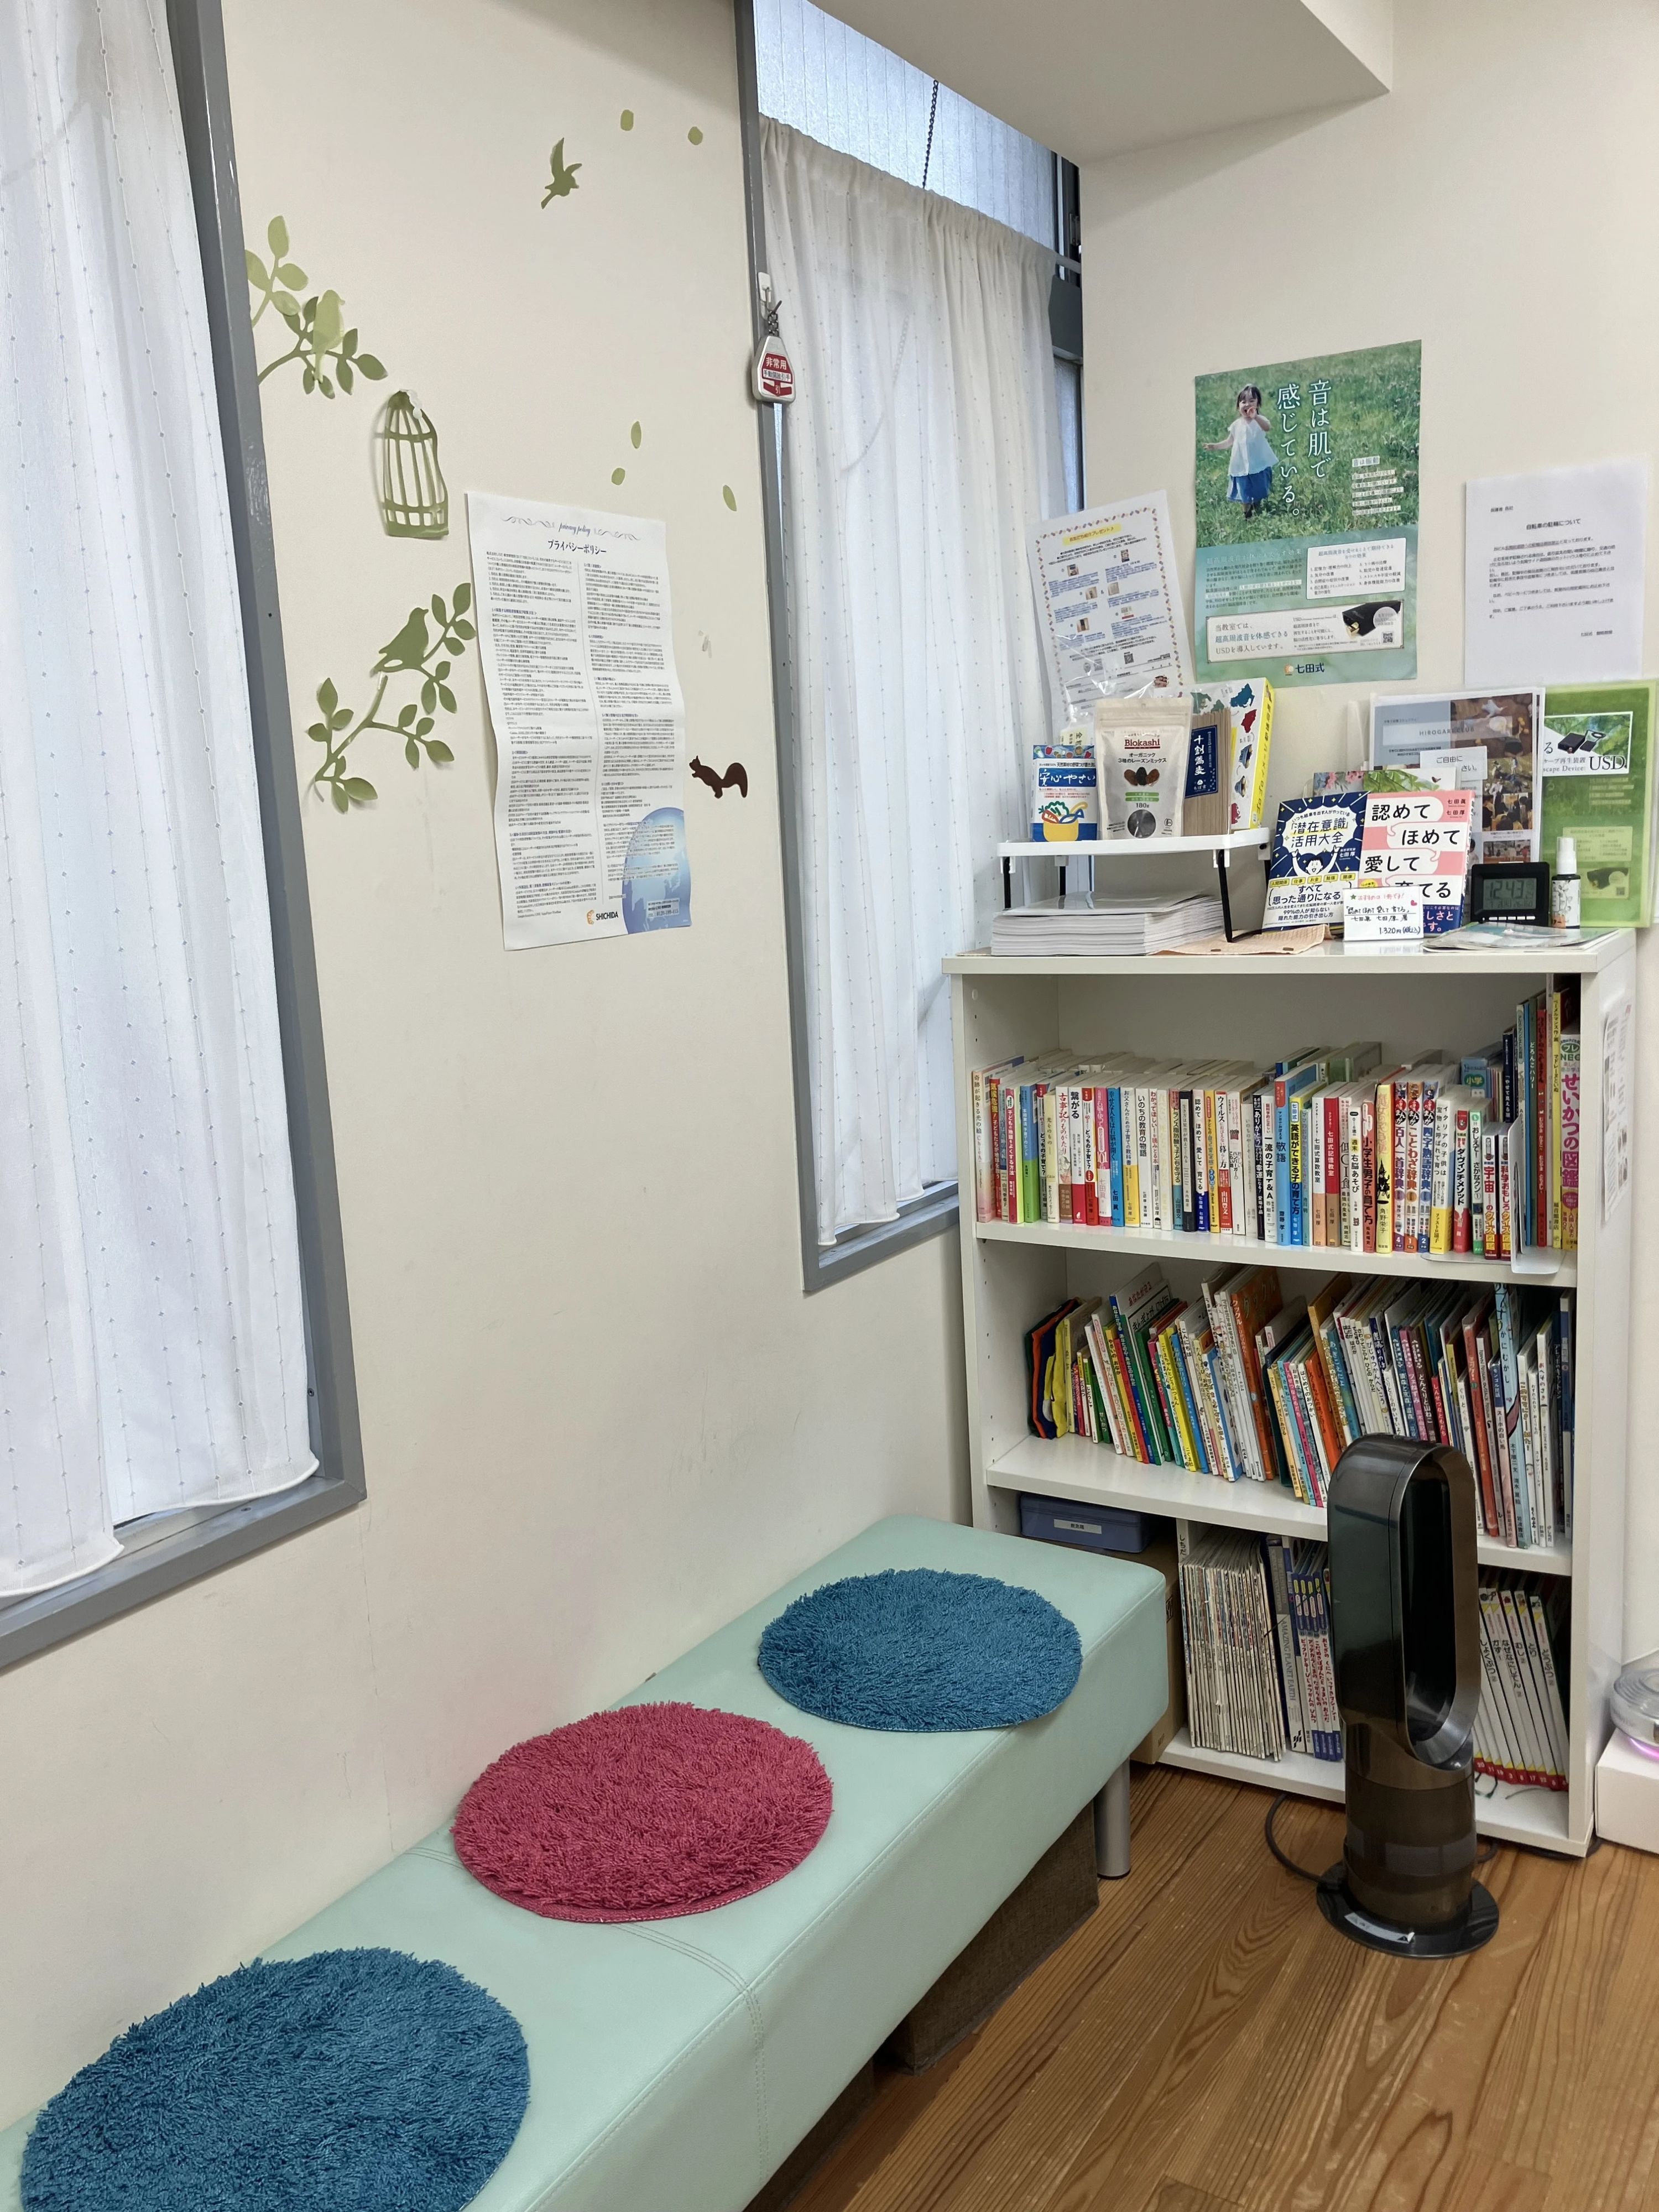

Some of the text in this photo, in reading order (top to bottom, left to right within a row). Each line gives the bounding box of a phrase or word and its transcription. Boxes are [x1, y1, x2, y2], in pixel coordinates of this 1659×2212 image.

[765, 357, 787, 371] 非常用
[775, 385, 781, 394] 引
[1308, 379, 1332, 479] 音は肌で
[1277, 384, 1301, 517] 感じている。
[1526, 518, 1581, 530] 自転車の駐輪について
[547, 539, 607, 555] プライバシーポリシー
[1215, 623, 1253, 632] 当教室では、
[1215, 630, 1288, 643] 超高周波音を体感できる
[1295, 662, 1325, 674] 七田式
[1124, 738, 1160, 747] Biokashi
[1436, 755, 1463, 764] ご自由に
[1589, 755, 1626, 771] USD
[1040, 769, 1095, 786] 安心やさい
[1291, 817, 1348, 834] 「潜在意識」
[1371, 804, 1431, 821] 認めて
[1291, 831, 1344, 848] 活用大全
[1401, 829, 1460, 846] ほめて
[1364, 855, 1420, 873] 愛して
[1272, 891, 1342, 905] 思った通りになる
[1298, 884, 1323, 894] すべて
[596, 911, 619, 921] SHICHIDA
[1277, 912, 1334, 921] 隠れた能力の引き出し方
[1283, 907, 1330, 915] 99%の人が知らない
[974, 1074, 982, 1134] 奇跡が起きる光の絵
[1070, 1091, 1080, 1119] 繋がる
[1058, 1092, 1070, 1155] 古事記のものがたり
[1138, 1095, 1147, 1157] いのちの教育の物語
[1561, 1073, 1580, 1188] せいかつの図鑑
[1276, 1141, 1287, 1163] 敬語
[1434, 1107, 1442, 1175] 宝物と呼ばれて育つ
[1440, 1106, 1448, 1176] イタリアの子供は
[1291, 1124, 1300, 1215] 英語ができる子の育て方
[1394, 1126, 1405, 1190] 百人一首辞典
[1406, 1127, 1418, 1191] ことわざ辞典
[1421, 1126, 1433, 1190] 四字熟語辞典
[1350, 1154, 1359, 1193] 右脳あそび
[1363, 1137, 1373, 1225] 小学生男子の育て方
[1456, 1149, 1466, 1206] ダ・ヴィンチ・メソッド
[1484, 1166, 1495, 1193] 宇宙
[1181, 1328, 1192, 1357] こんにちは
[1500, 1331, 1510, 1384] かにむかし
[1365, 1341, 1386, 1405] びじゅつかんへいこう
[1300, 1370, 1316, 1418] はじめてのおつかい
[1433, 1384, 1447, 1437] しんせつなともだち
[1496, 1411, 1506, 1450] スーホの白い馬
[1281, 1620, 1296, 1701] AMAZING PLANET EARTH
